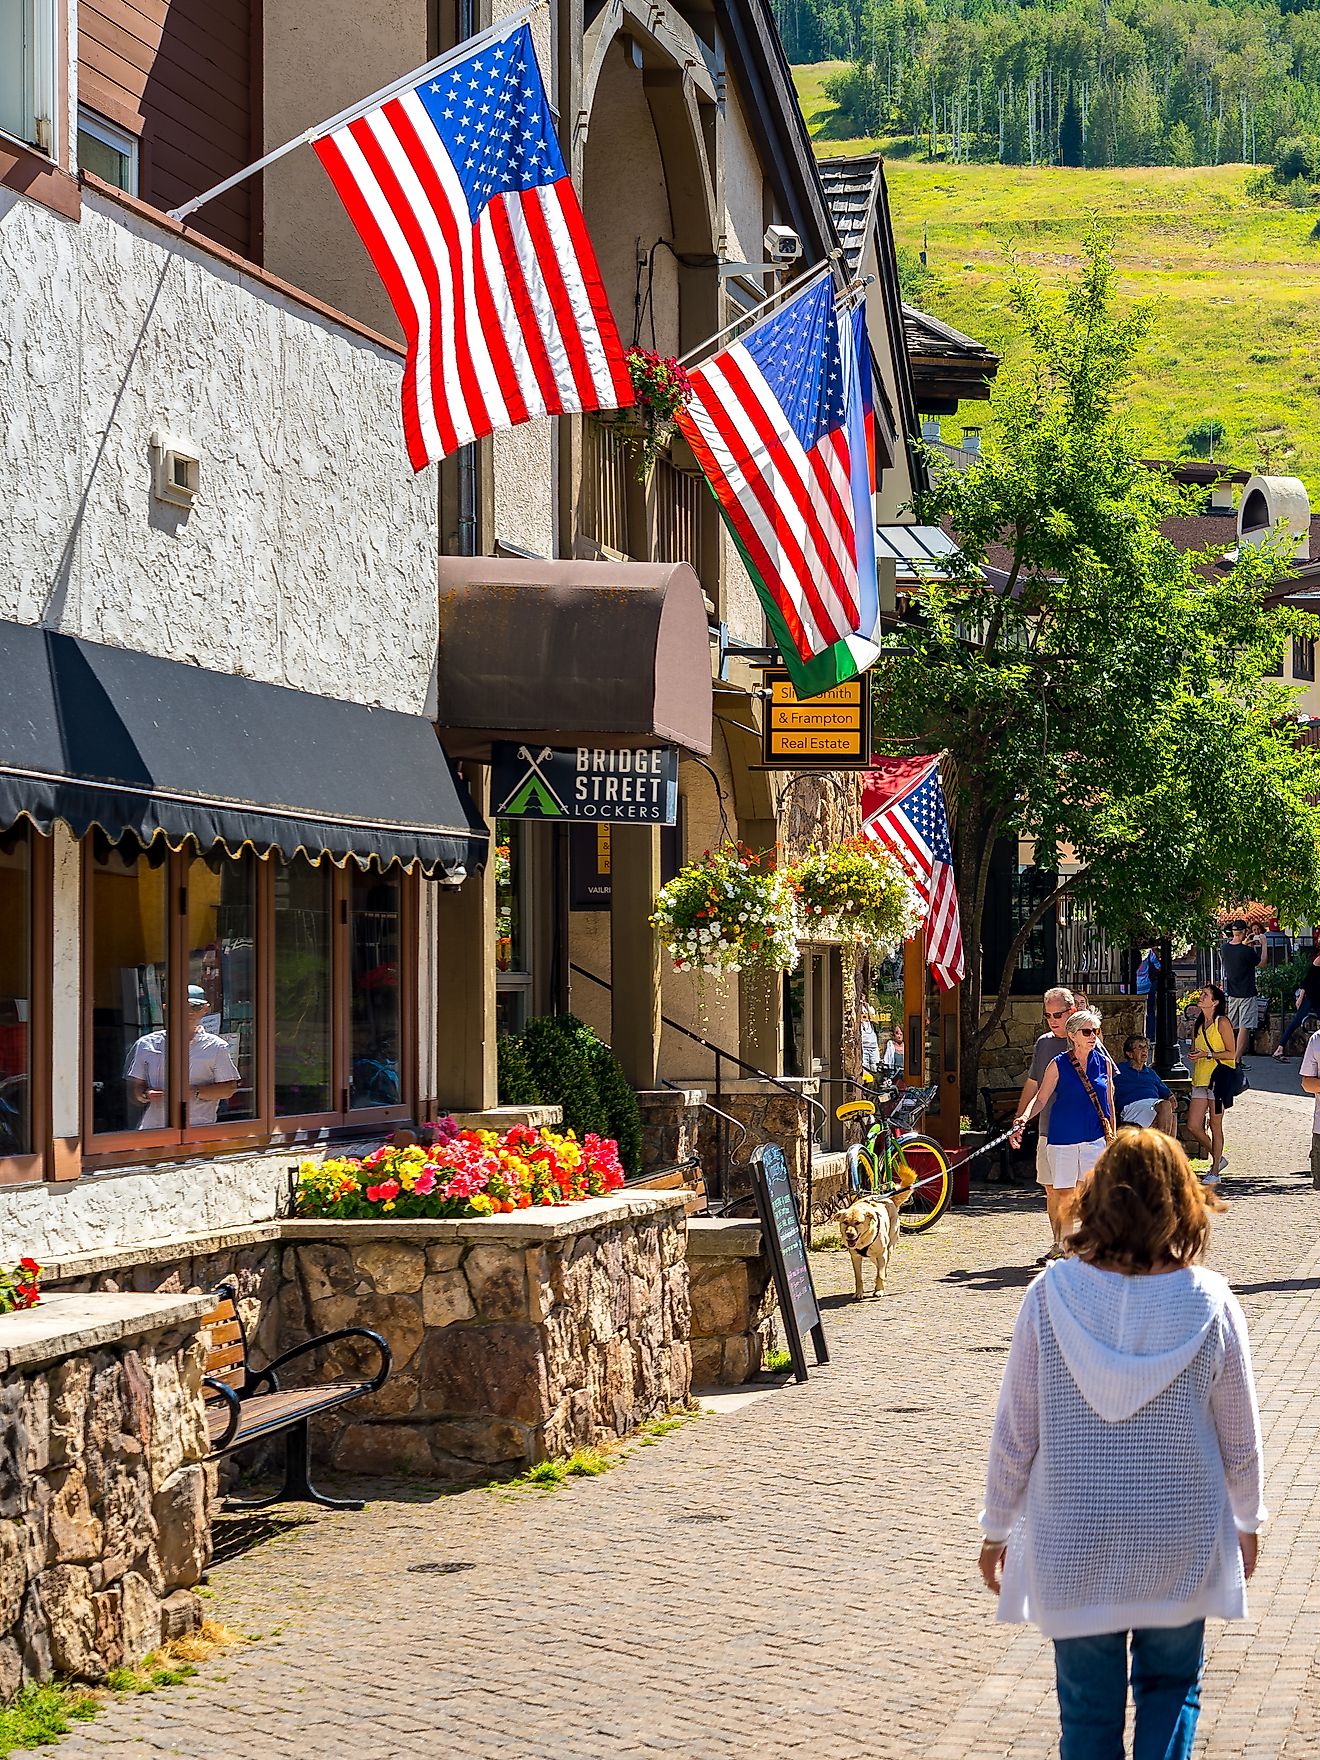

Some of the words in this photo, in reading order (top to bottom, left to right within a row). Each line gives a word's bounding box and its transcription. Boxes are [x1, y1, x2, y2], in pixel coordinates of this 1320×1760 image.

[779, 712, 788, 723] &
[791, 712, 853, 726] Frampton
[781, 737, 808, 749] Real
[811, 737, 850, 749] Estate
[576, 747, 662, 774] BRIDGE
[575, 776, 661, 802] STREET
[575, 804, 660, 818] LOCKERS
